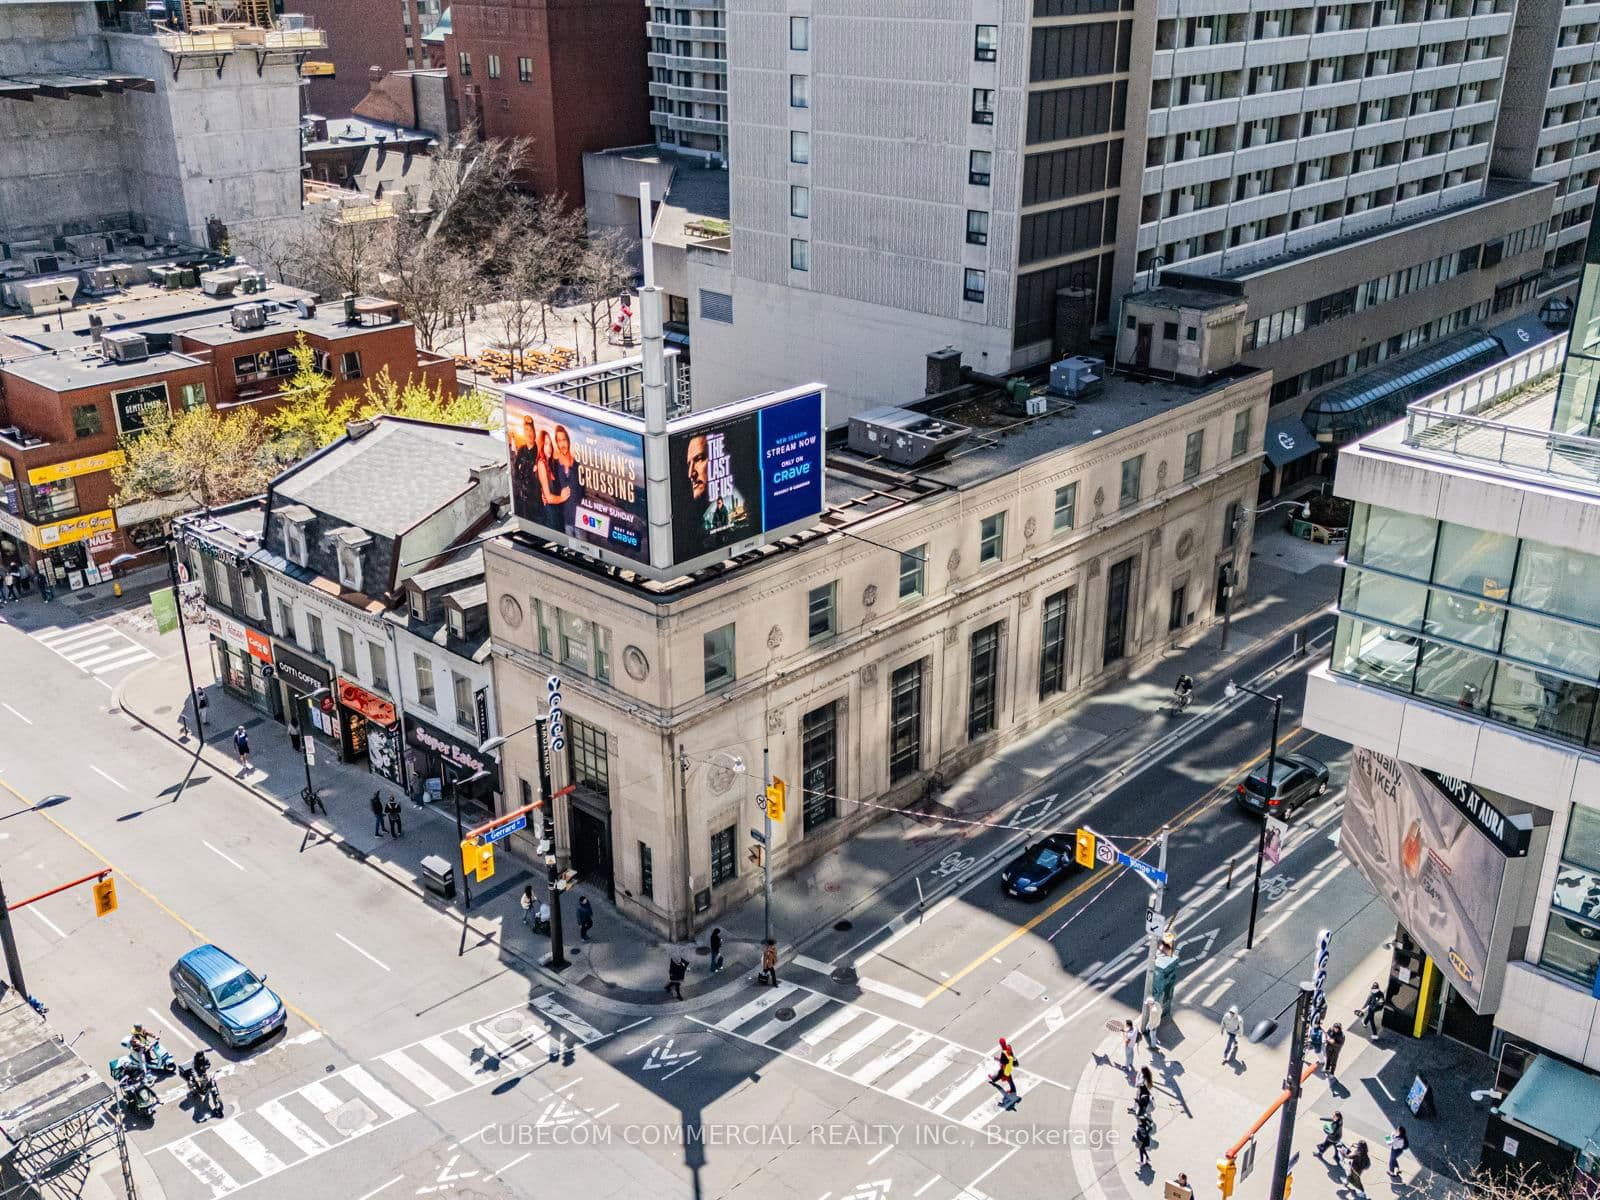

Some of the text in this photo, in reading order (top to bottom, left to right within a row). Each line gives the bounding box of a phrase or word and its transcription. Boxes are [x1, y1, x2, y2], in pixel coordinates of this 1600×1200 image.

[708, 437, 725, 460] THE
[766, 435, 816, 458] STREAM NOW
[575, 442, 635, 480] SULLIVAN'S
[708, 455, 730, 482] LAST
[781, 458, 795, 468] ONLY
[578, 465, 635, 503] CROSSING
[708, 475, 733, 502] OF US
[581, 499, 634, 523] ALL NEW SUNDAY
[88, 532, 113, 546] NAILS
[280, 662, 321, 689] COTTI COFFEE
[416, 727, 450, 754] Super
[1375, 768, 1396, 803] IKEA
[1467, 791, 1480, 814] AT
[1478, 802, 1504, 840] AURA
[491, 821, 516, 839] Gerrard
[1130, 858, 1150, 874] Yonge
